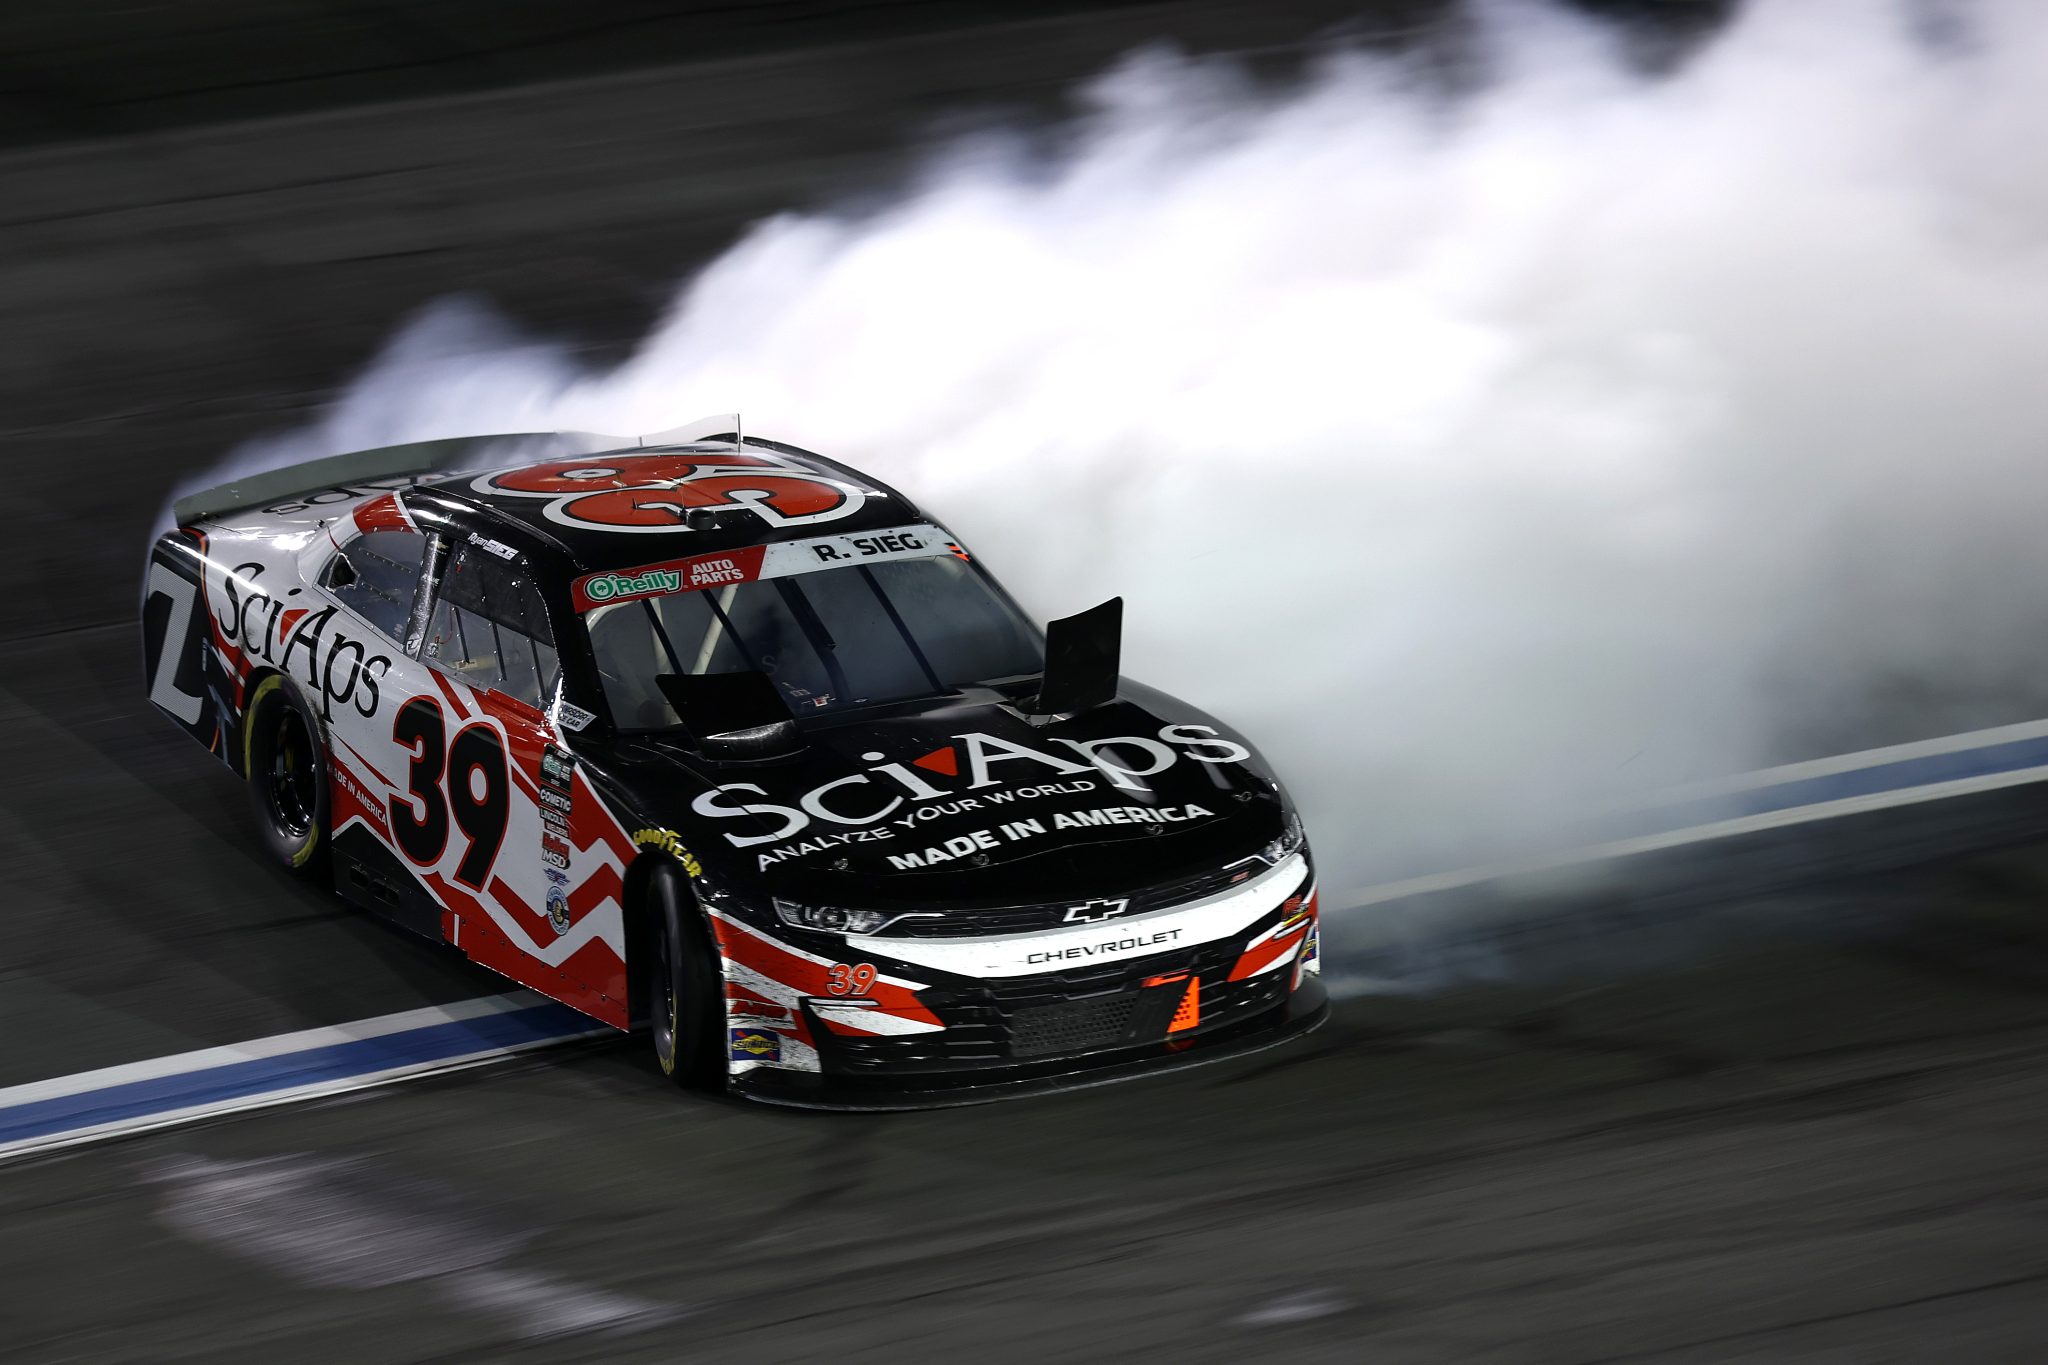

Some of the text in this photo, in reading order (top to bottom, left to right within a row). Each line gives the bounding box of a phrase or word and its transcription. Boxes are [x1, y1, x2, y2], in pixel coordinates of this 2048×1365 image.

[467, 532, 519, 560] Ryan SIEG
[816, 533, 924, 562] R. SIEG
[584, 558, 734, 602] O'Reilly AUTO
[690, 567, 744, 586] PARTS
[217, 562, 393, 725] SciAps
[347, 780, 356, 795] IN
[355, 789, 387, 827] AMERICA
[390, 694, 511, 894] 39
[691, 724, 1251, 848] SciAps
[757, 780, 1096, 873] ANALYZE YOUR WORLD
[886, 803, 1215, 870] MADE IN AMERICA
[542, 850, 568, 869] MSD
[1027, 928, 1183, 964] CHEVROLET
[826, 963, 878, 996] 39
